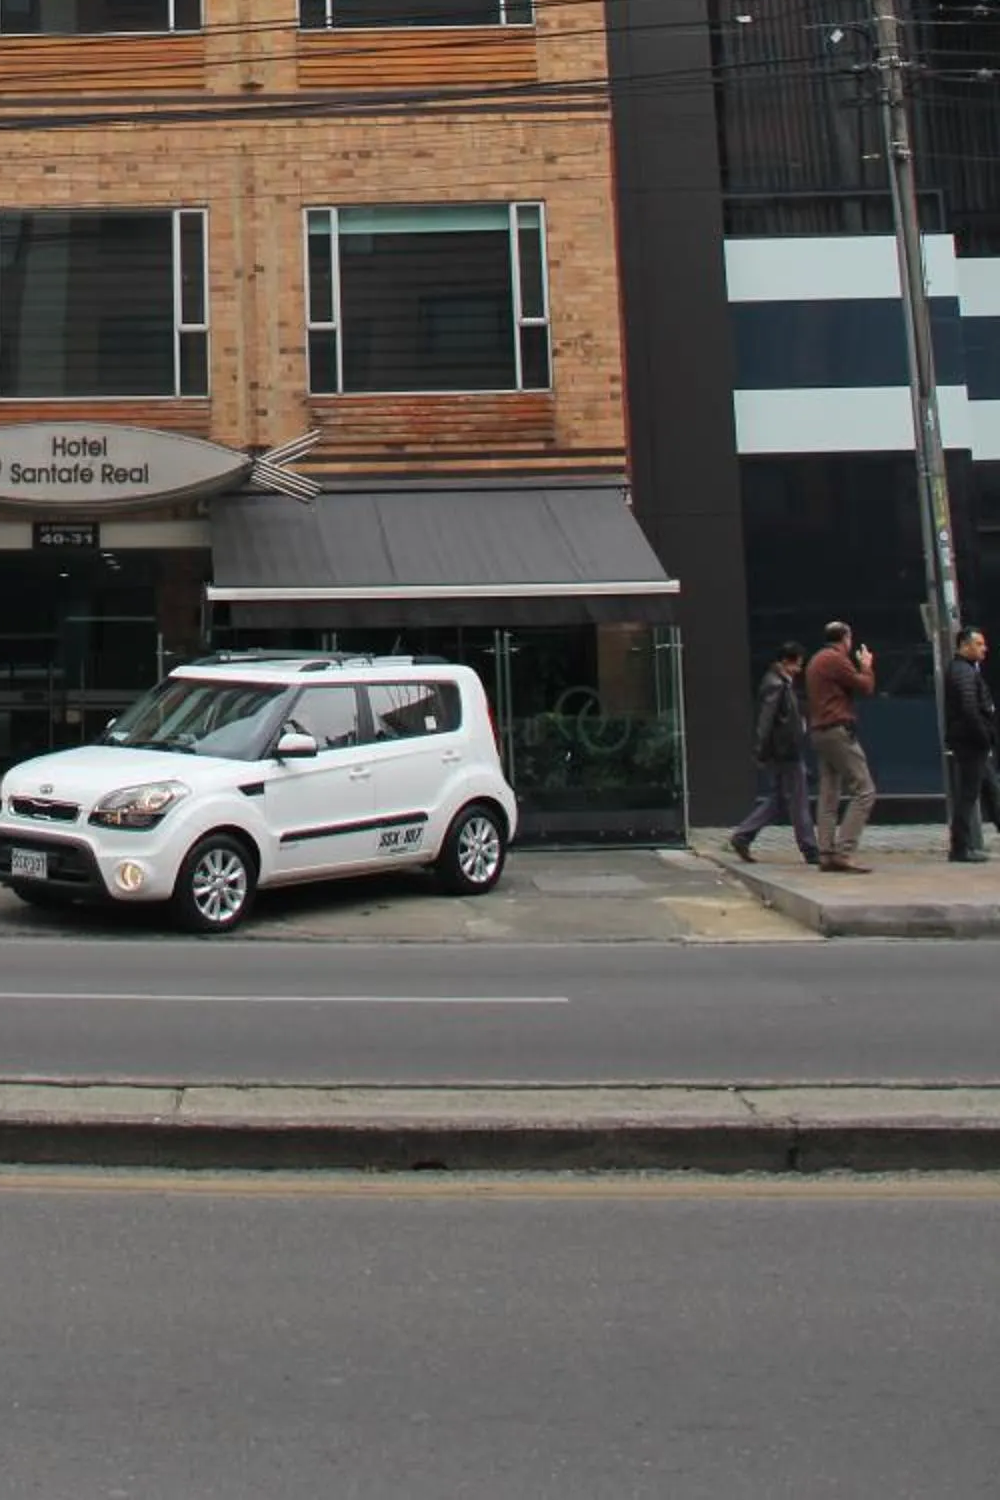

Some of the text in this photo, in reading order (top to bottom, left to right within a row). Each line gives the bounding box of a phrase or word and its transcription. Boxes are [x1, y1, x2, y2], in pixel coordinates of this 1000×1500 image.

[51, 435, 108, 457] Hotel
[101, 463, 150, 484] Real
[40, 533, 93, 545] 40-31
